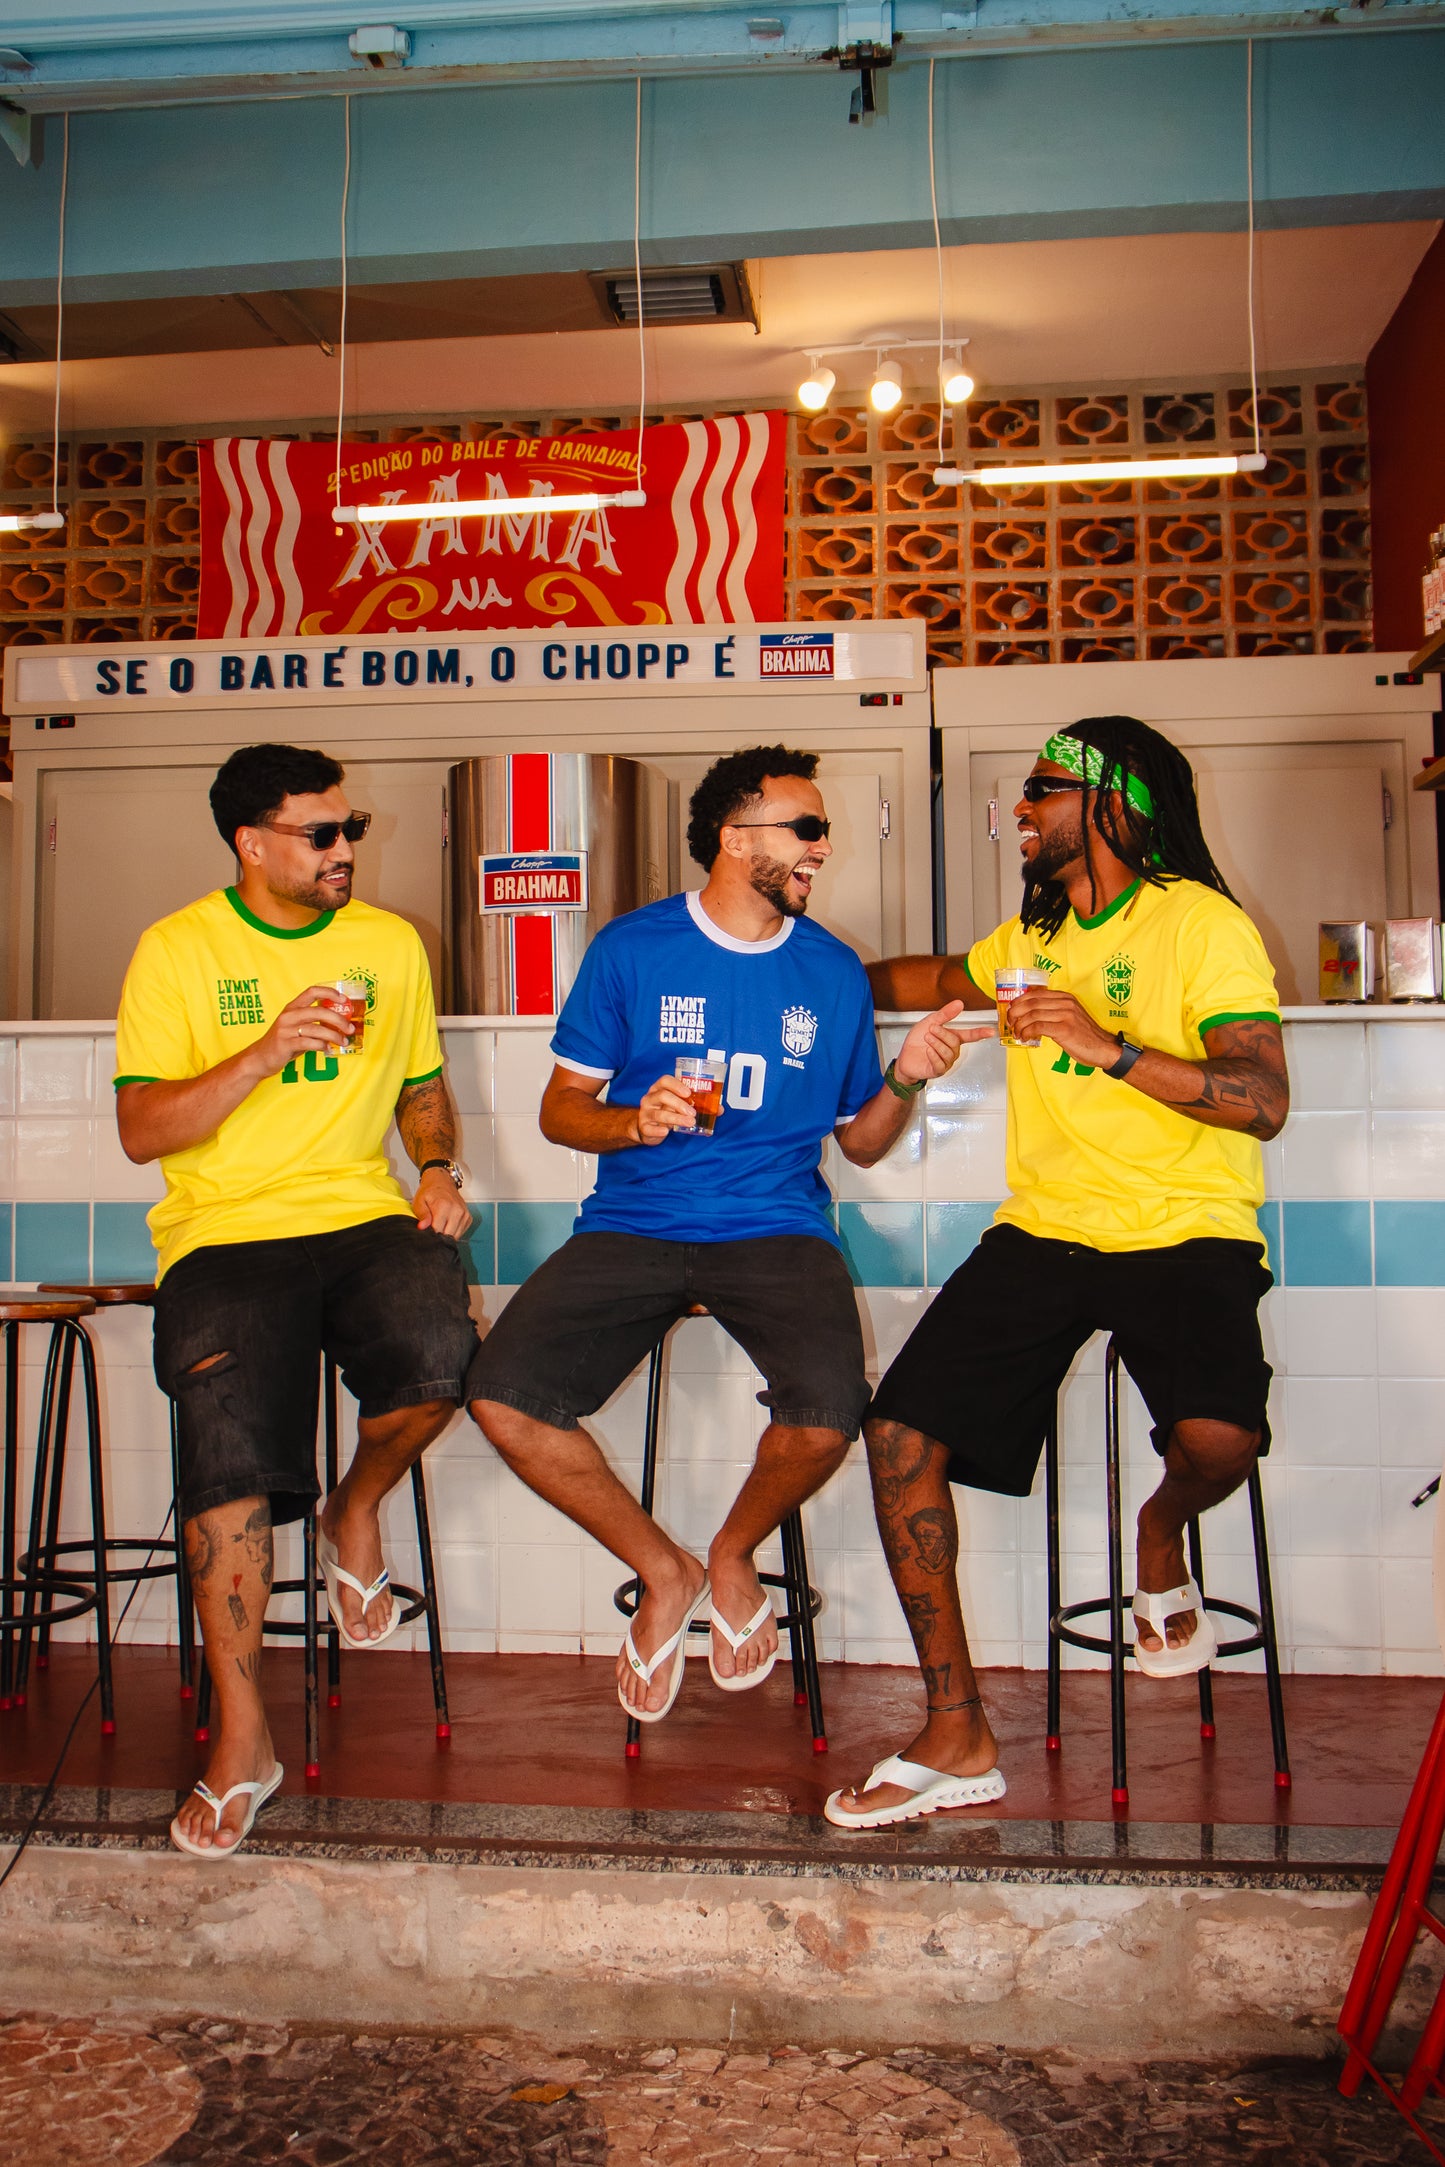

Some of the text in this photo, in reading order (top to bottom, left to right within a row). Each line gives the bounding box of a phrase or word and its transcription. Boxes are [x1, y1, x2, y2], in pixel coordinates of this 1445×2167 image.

[350, 450, 413, 481] EDIÇÃO
[421, 445, 444, 466] DO
[451, 439, 508, 462] BAILE
[515, 440, 542, 458] DE
[547, 441, 641, 473] CARNAVAL
[332, 469, 623, 590] XAMA
[441, 577, 513, 615] NA
[782, 634, 814, 645] Chopp
[96, 659, 148, 695] SE
[169, 657, 195, 693] O
[362, 649, 474, 688] BOM,
[491, 646, 516, 682] O
[543, 643, 690, 681] CHOPP
[714, 635, 736, 678] É
[762, 649, 831, 673] BRAHMA
[511, 859, 553, 870] Chopp
[493, 874, 570, 901] BRAHMA
[1323, 958, 1359, 975] 27
[217, 978, 259, 994] LVMNT
[219, 994, 263, 1010] SAMBA
[660, 995, 707, 1012] LVMNT
[220, 1009, 265, 1026] CLUBE
[660, 1011, 706, 1028] SAMBA
[659, 1027, 705, 1044] CLUBE
